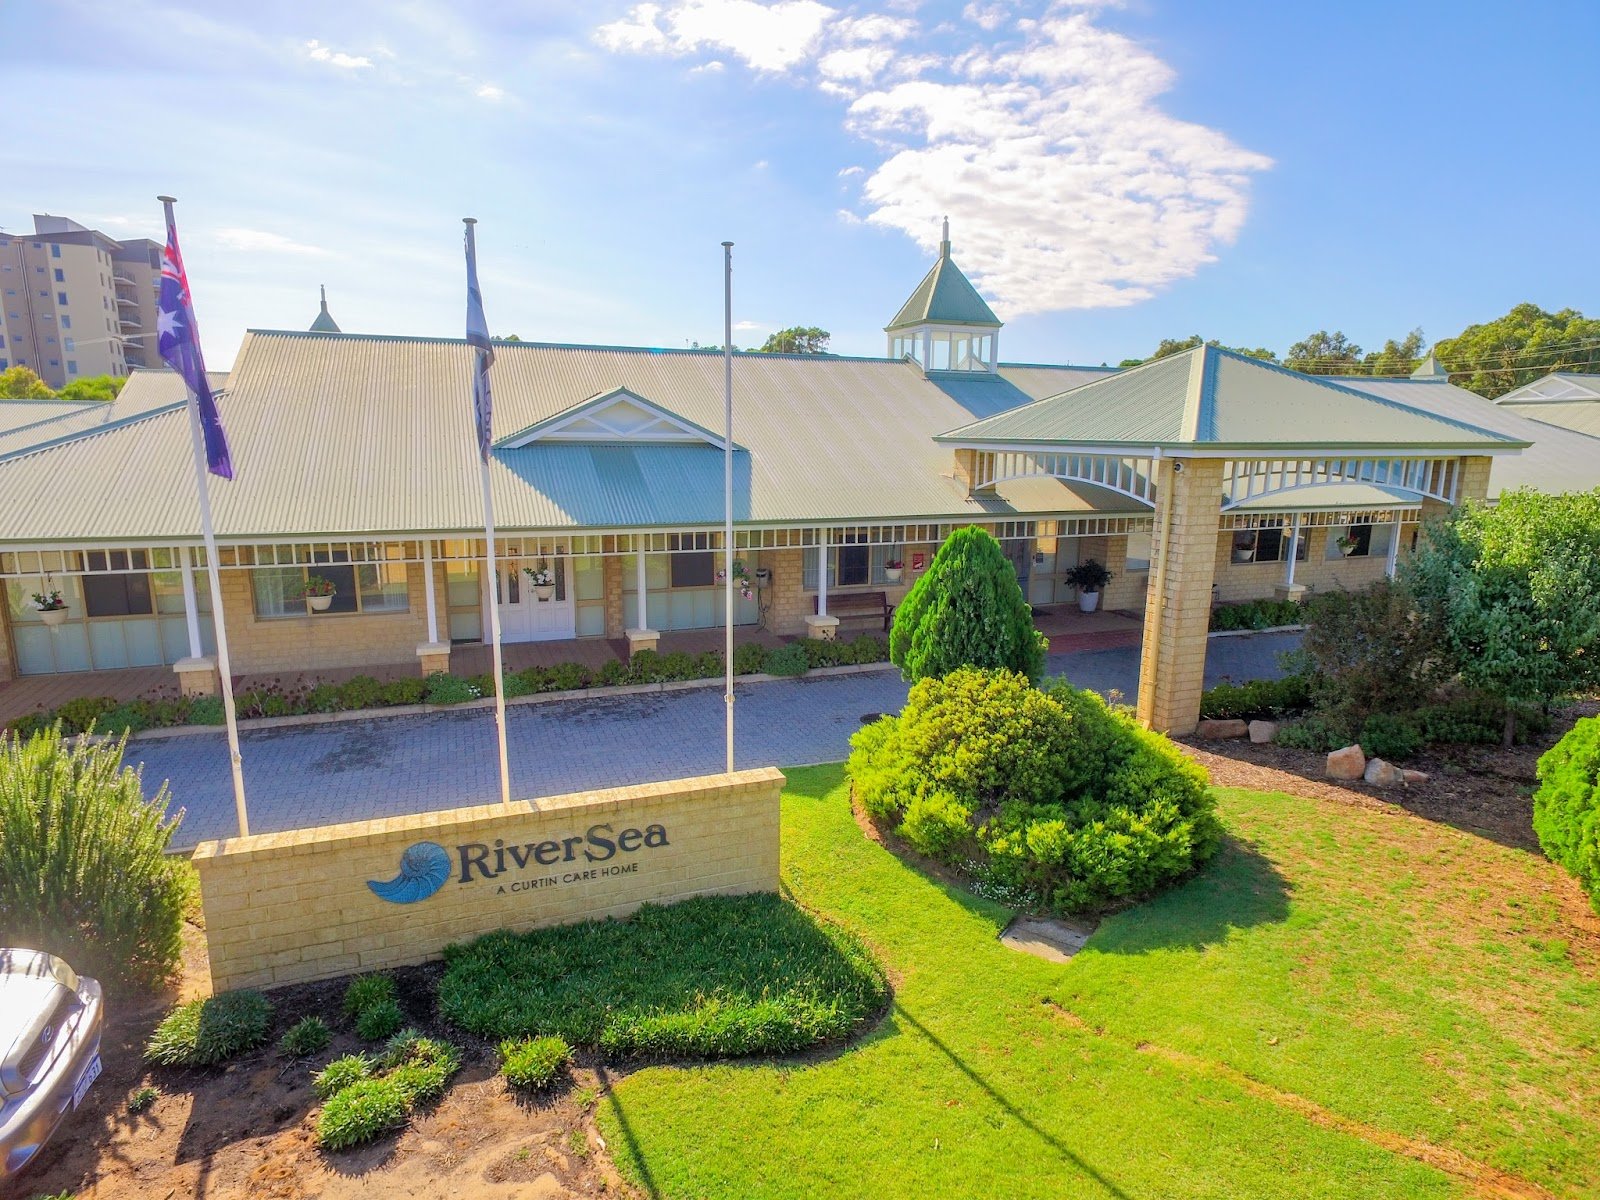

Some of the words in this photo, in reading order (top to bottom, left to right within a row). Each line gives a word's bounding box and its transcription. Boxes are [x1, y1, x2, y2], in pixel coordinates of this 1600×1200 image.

[456, 823, 670, 883] RiverSea
[496, 885, 506, 895] A
[511, 876, 557, 892] CURTIN
[562, 869, 597, 884] CARE
[601, 862, 639, 877] HOME
